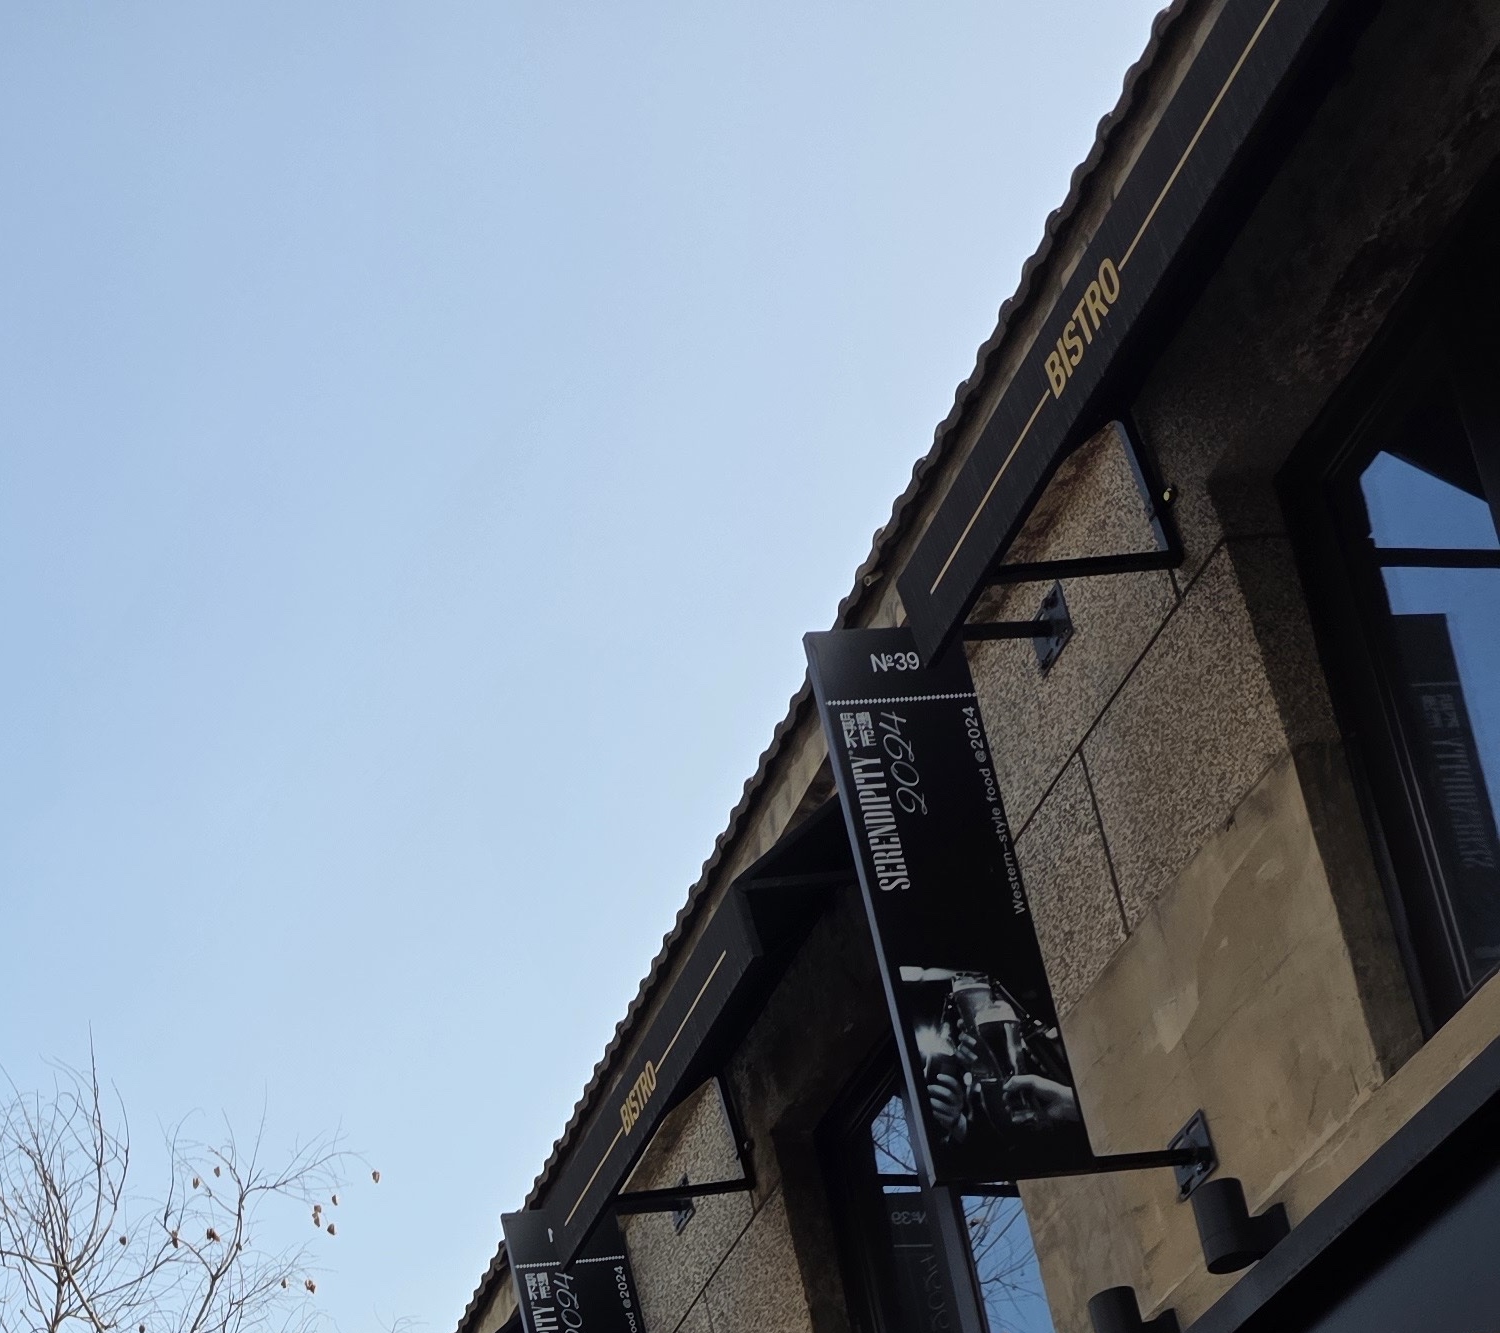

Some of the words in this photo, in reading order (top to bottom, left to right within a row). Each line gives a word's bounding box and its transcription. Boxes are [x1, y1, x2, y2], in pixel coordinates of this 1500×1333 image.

[1045, 258, 1120, 398] BISTRO
[879, 711, 928, 815] 2024
[962, 706, 987, 763] @2024
[851, 757, 911, 891] SERENDIPITY
[978, 768, 997, 801] food
[991, 806, 1026, 915] Western-style
[620, 1060, 656, 1136] BISTRO
[614, 1265, 632, 1309] @2024
